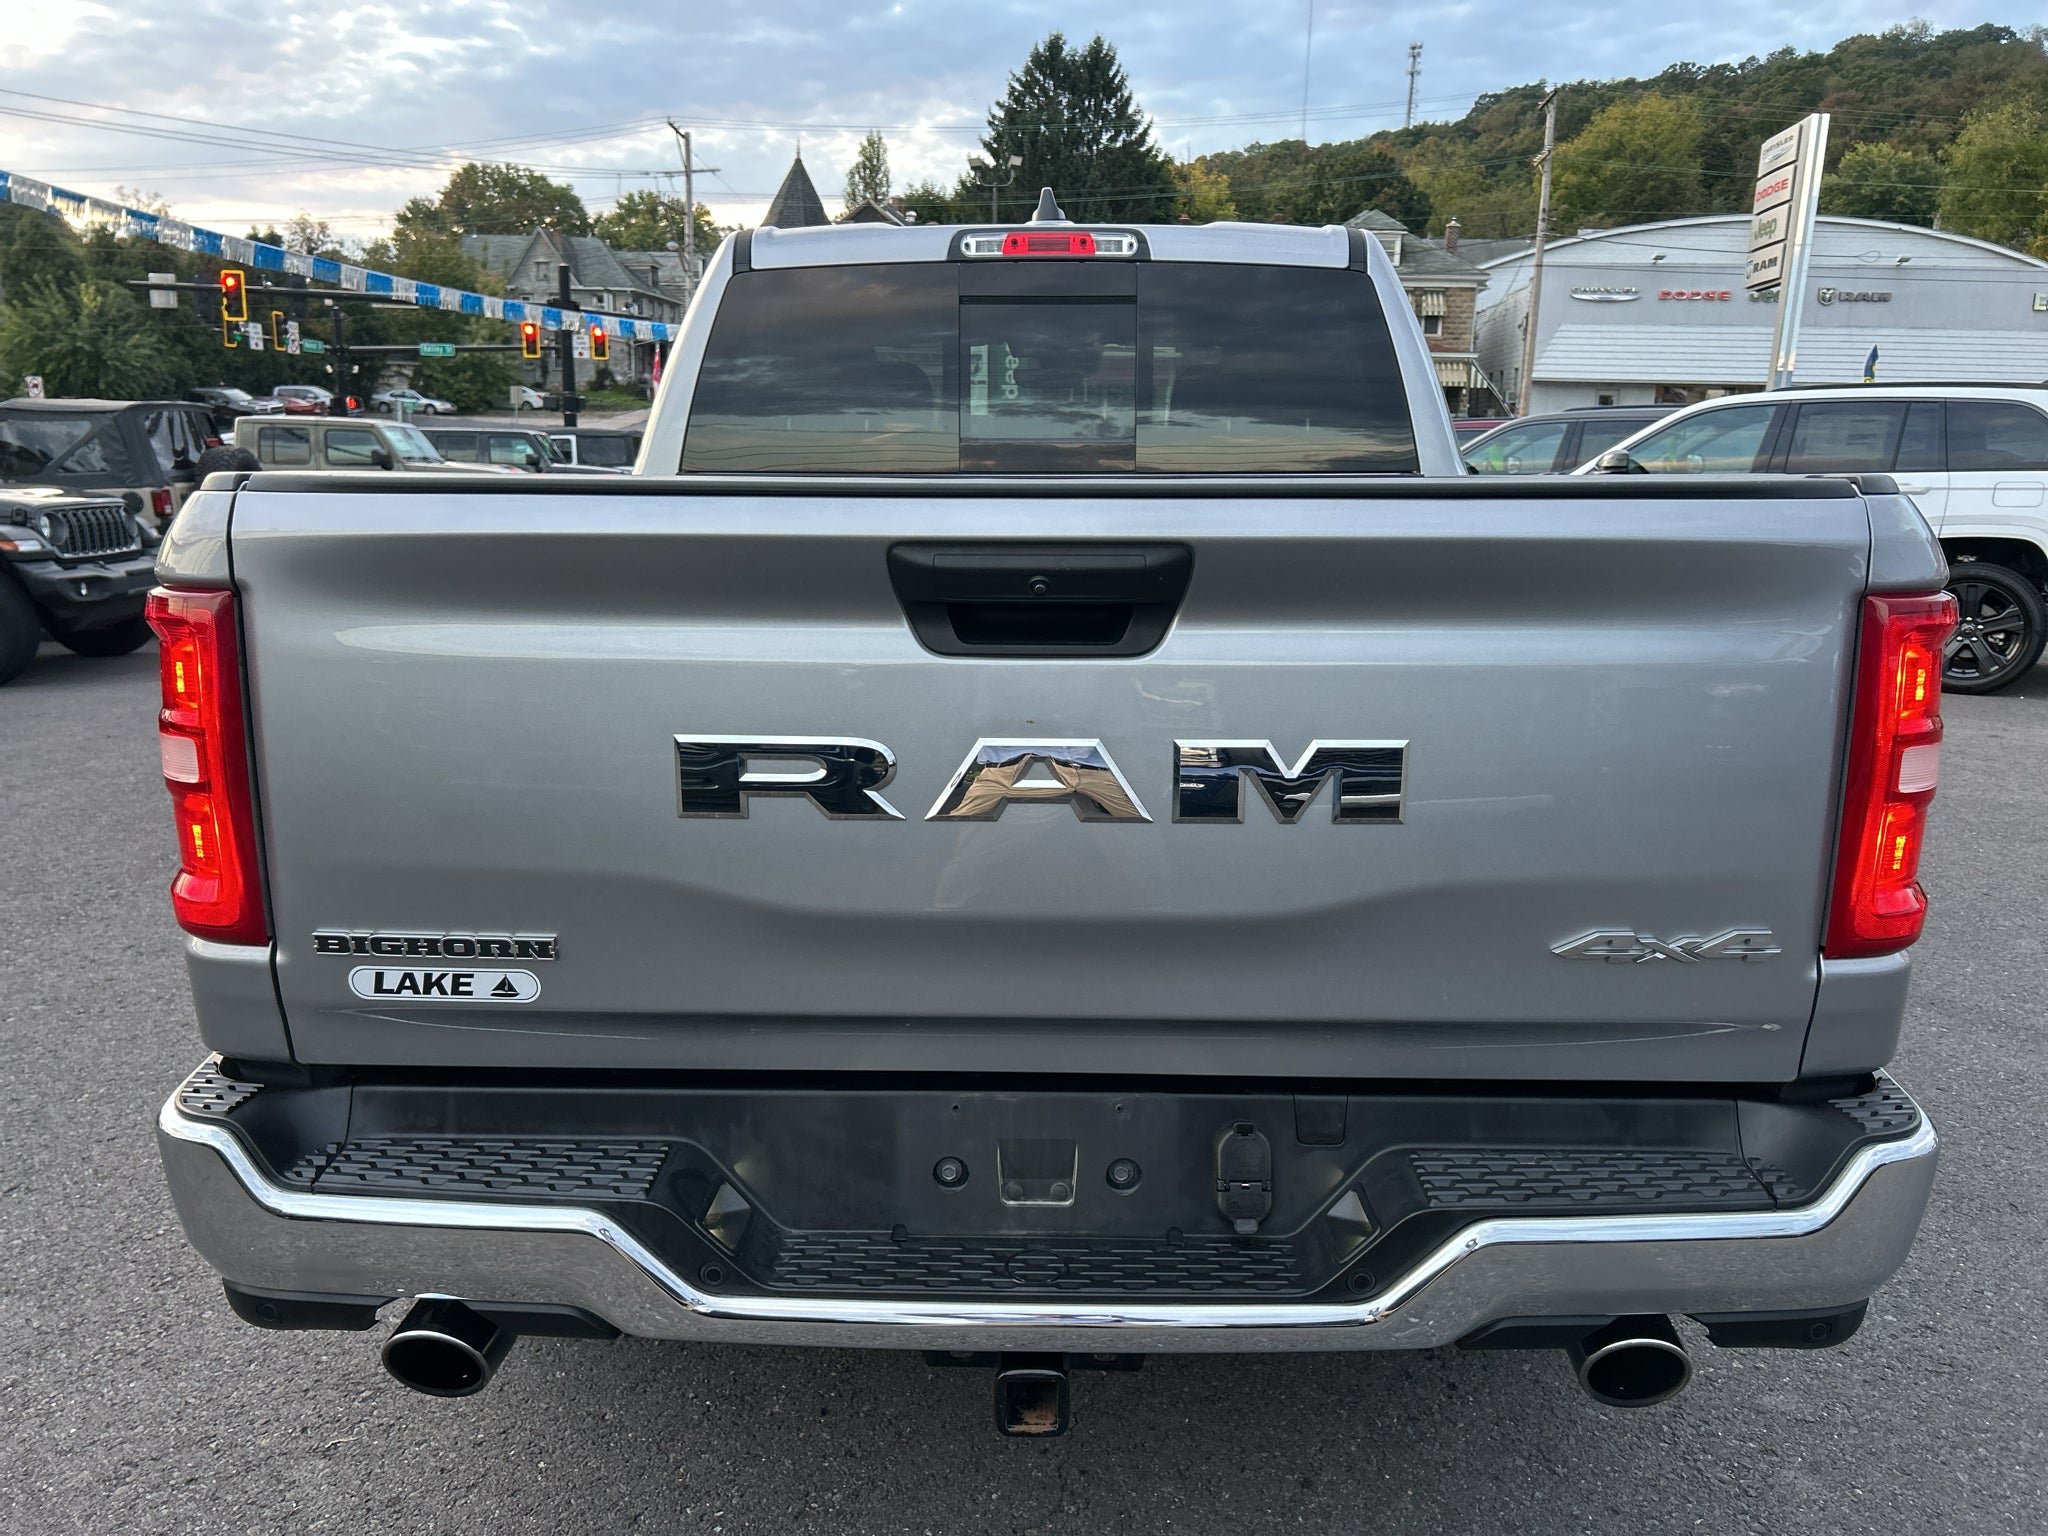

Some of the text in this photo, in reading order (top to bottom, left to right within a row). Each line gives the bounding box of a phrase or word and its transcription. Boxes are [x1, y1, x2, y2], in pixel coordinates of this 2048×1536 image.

[1756, 178, 1789, 203] DODGE
[1754, 218, 1777, 240] Jeep
[1753, 256, 1778, 273] RAM
[1658, 289, 1732, 301] DODGE
[1838, 291, 1893, 303] RAM
[673, 734, 1411, 824] RAM
[313, 931, 558, 960] BIGHORN
[373, 971, 475, 996] LAKE
